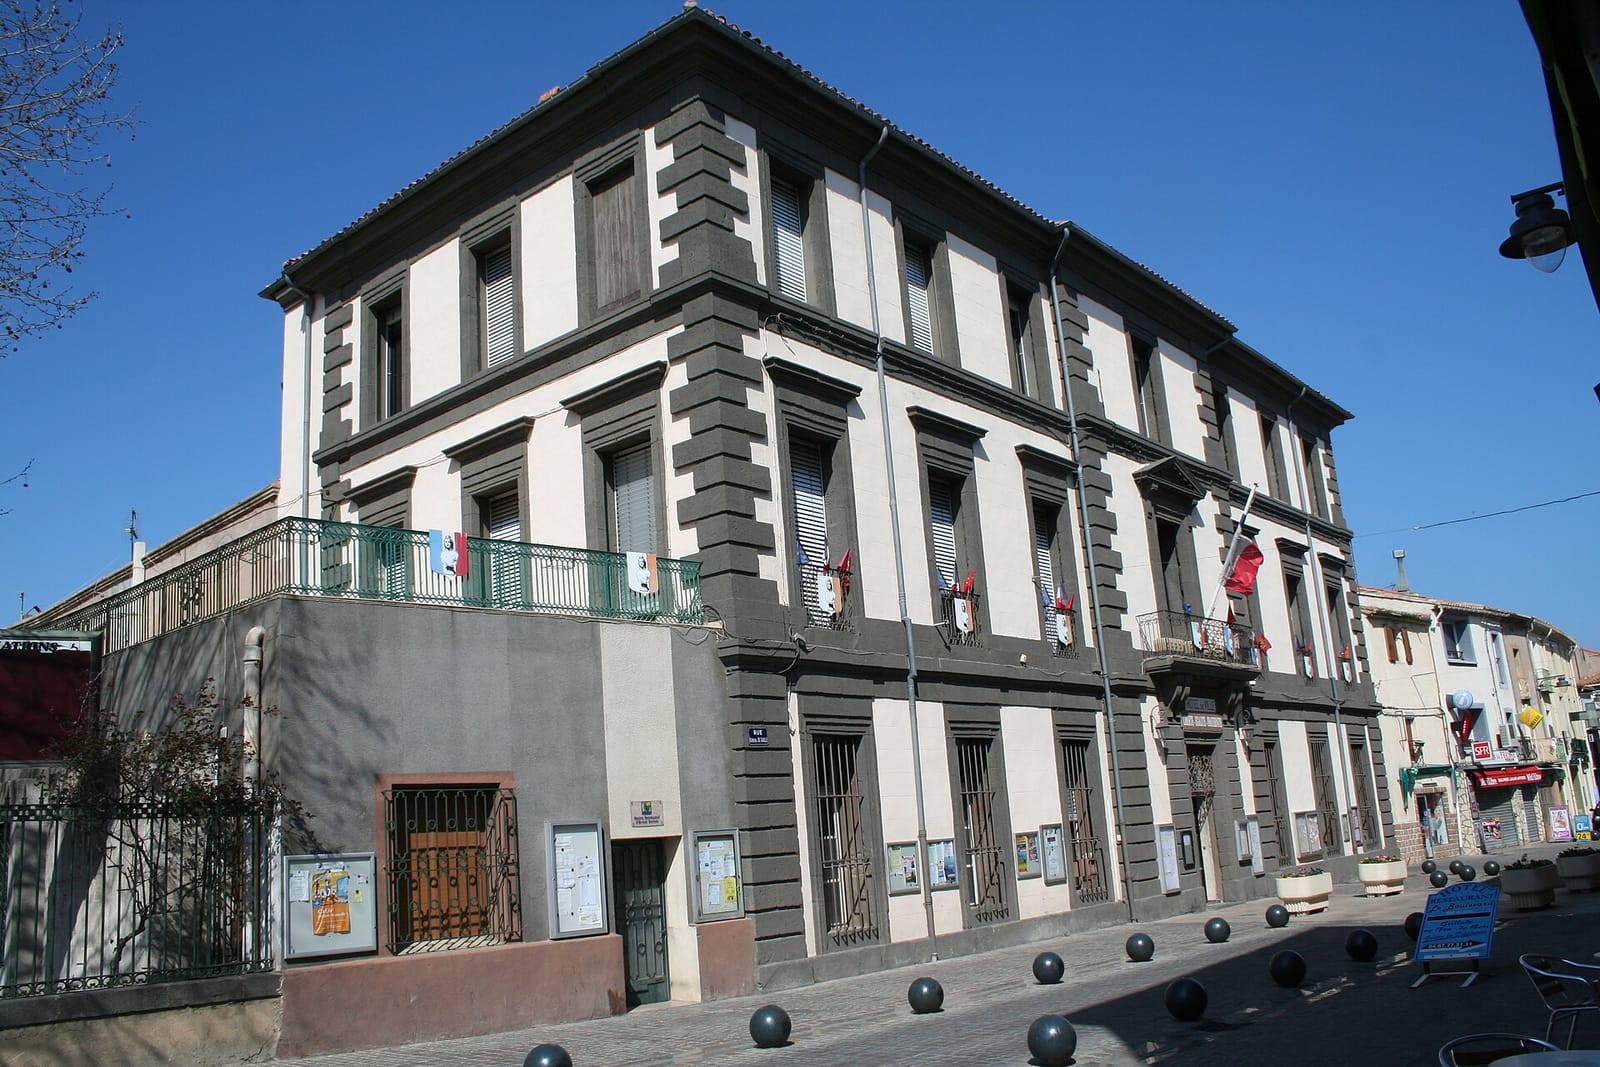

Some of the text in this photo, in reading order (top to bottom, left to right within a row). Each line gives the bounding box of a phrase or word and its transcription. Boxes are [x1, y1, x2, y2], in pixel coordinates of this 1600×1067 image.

[1474, 746, 1490, 756] SFR
[1440, 884, 1487, 897] HOTEL
[1431, 894, 1494, 904] RESTAURANT
